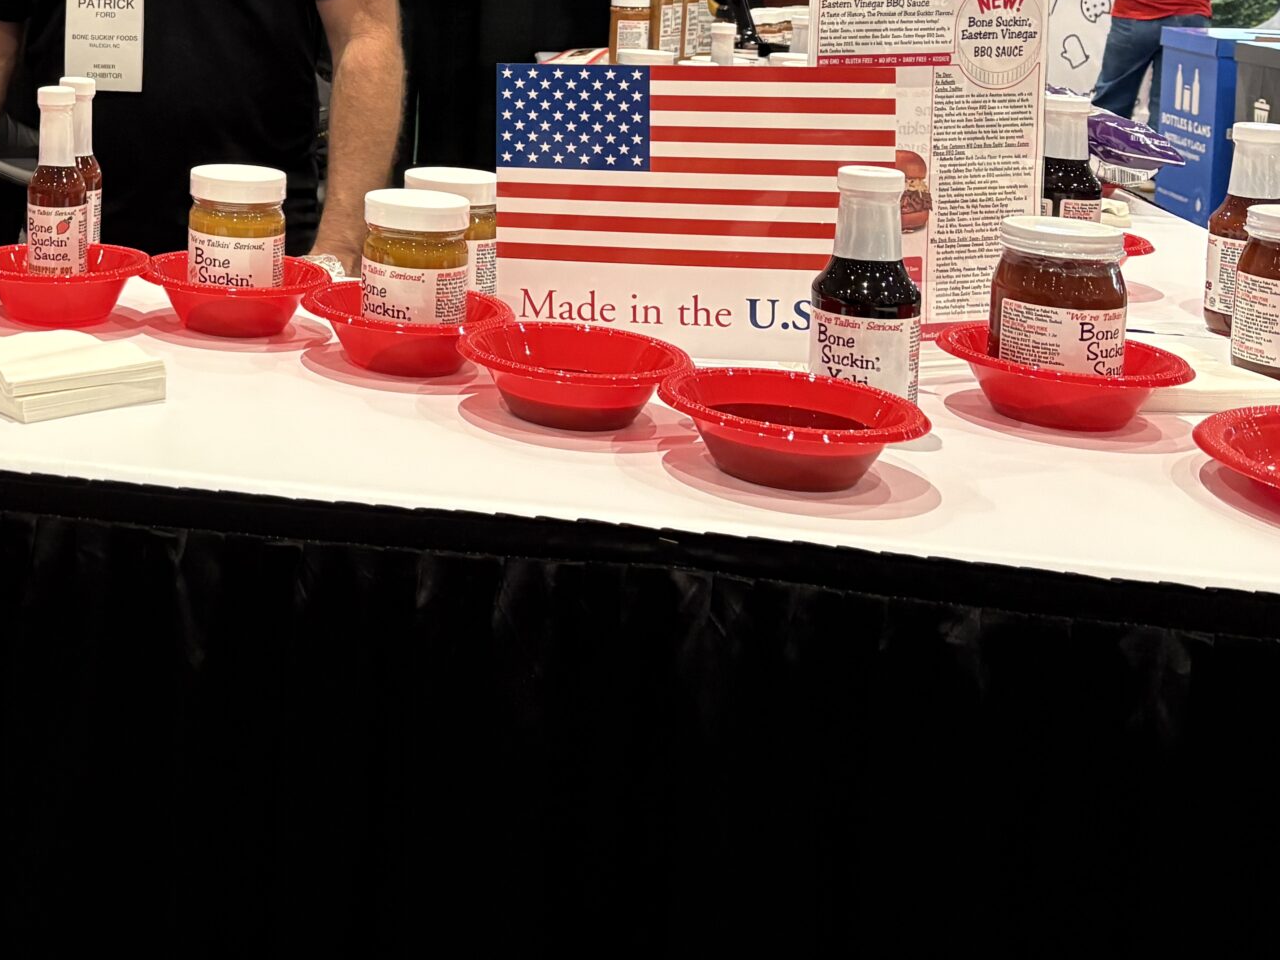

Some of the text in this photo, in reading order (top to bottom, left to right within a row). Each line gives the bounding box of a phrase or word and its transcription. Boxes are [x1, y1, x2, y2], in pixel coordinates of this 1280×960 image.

[821, 0, 852, 9] Eastern
[854, 0, 885, 10] Vinegar
[886, 0, 904, 8] BBQ
[968, 17, 994, 28] Bone
[961, 29, 1038, 41] Eastern Vinegar
[974, 45, 1024, 58] BBQ SAUCE
[29, 217, 53, 233] Bone
[31, 232, 70, 247] Suckin'
[206, 239, 231, 249] Talkin'
[195, 246, 230, 268] Bone
[198, 266, 252, 287] Suckin'
[519, 288, 810, 331] Made in the U.S
[1066, 311, 1099, 320] "We're
[834, 317, 863, 329] Talkin'
[817, 322, 855, 348] Bone
[1079, 322, 1119, 341] Bone
[821, 344, 880, 370] Suckin'
